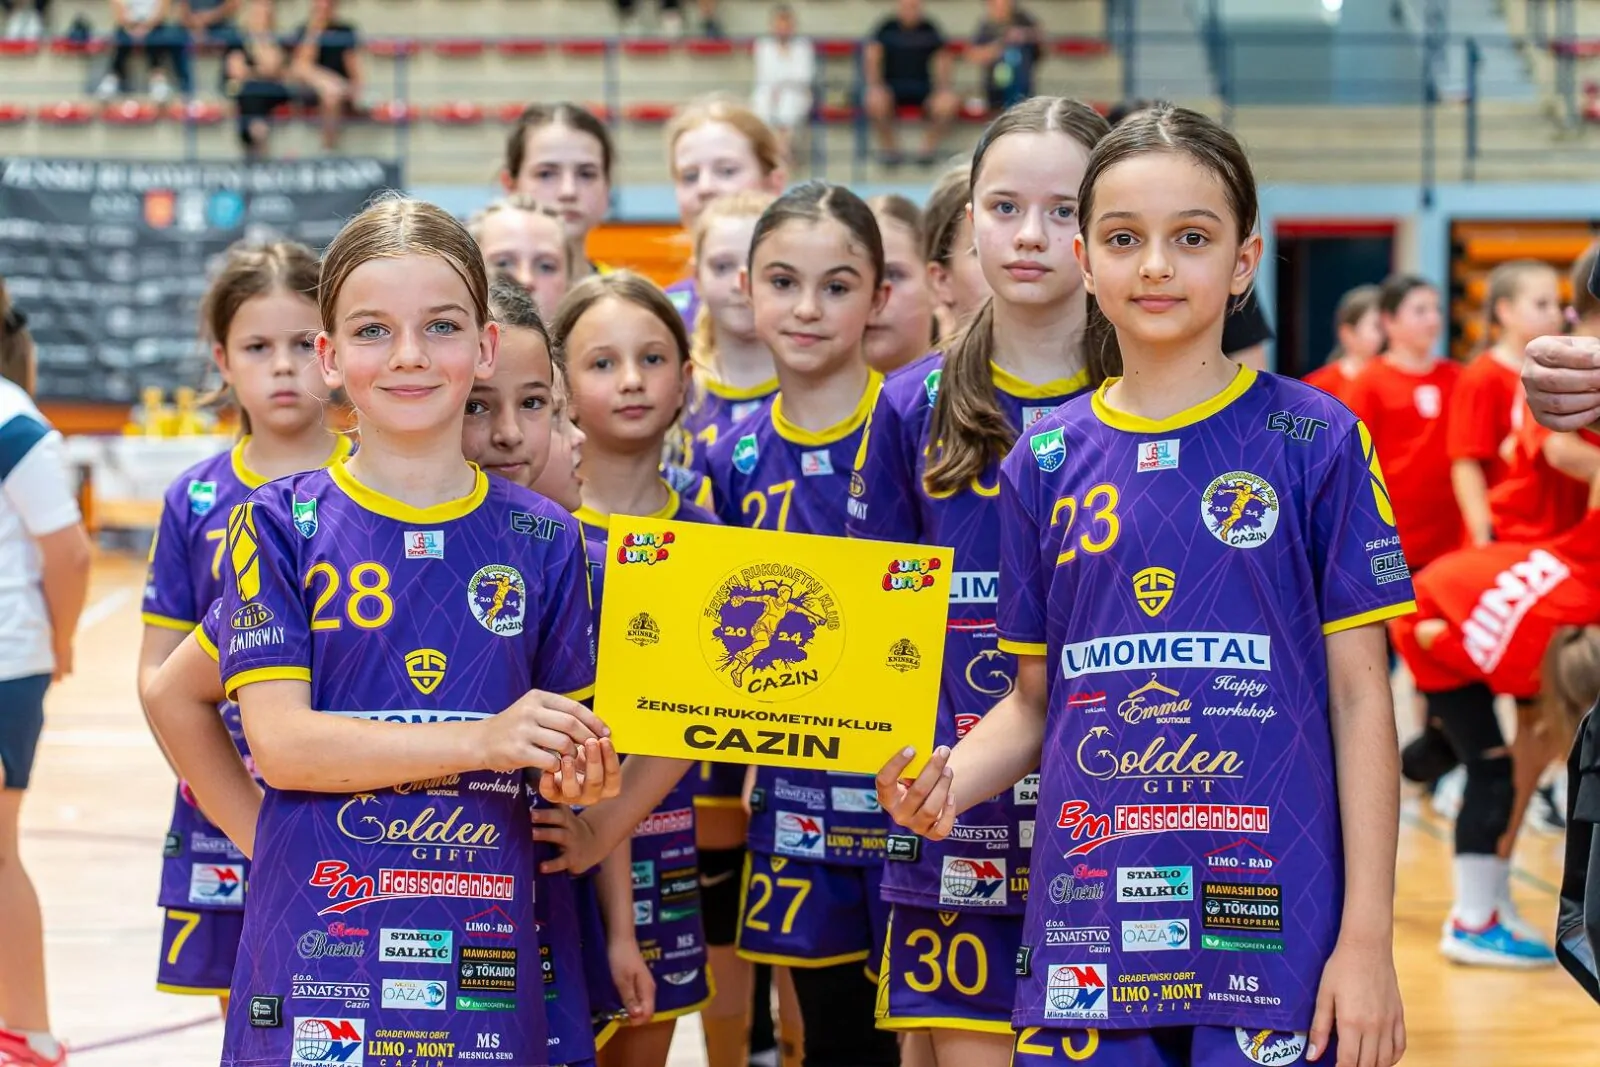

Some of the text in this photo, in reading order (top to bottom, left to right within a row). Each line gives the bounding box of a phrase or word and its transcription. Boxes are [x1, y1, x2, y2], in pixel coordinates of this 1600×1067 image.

[1266, 410, 1329, 442] EXIT
[742, 479, 795, 532] 27
[510, 510, 565, 541] EXIT
[1051, 483, 1120, 567] 23
[1231, 532, 1267, 545] CAZIN
[206, 528, 227, 581] 7
[304, 561, 394, 631] 28
[704, 563, 841, 631] ŽENSKI RUKOMETNI KLUB
[724, 626, 747, 637] 20
[778, 631, 803, 645] 24
[748, 669, 819, 693] CAZIN
[1213, 675, 1268, 697] Happy
[637, 696, 893, 732] ŽENSKI RUKOMETNI KLUB
[1117, 696, 1192, 724] Emma
[1202, 702, 1277, 723] workshop
[684, 724, 840, 760] CAZIN
[1077, 727, 1243, 780] Golden
[1143, 779, 1215, 793] GIFT
[337, 793, 499, 844] Golden
[1057, 800, 1269, 840] BM Fassadenbau
[412, 847, 477, 862] GIFT
[1208, 856, 1239, 867] LIMO
[1248, 857, 1273, 869] RAD
[309, 860, 514, 900] BM Fassadenbau
[1127, 870, 1181, 880] STAKLO
[1122, 882, 1189, 897] SALKIĆ
[1206, 884, 1279, 897] MAWASHI DOO
[745, 873, 812, 934] 27
[466, 922, 490, 932] LIMO
[497, 924, 513, 933] RAD
[1207, 916, 1280, 927] KARATE OPREMA
[167, 909, 200, 965] 7
[390, 932, 442, 941] STAKLO
[1046, 930, 1110, 942] ZANATSTVO
[1124, 929, 1167, 943] OAZA
[385, 946, 448, 958] SALKIĆ
[1089, 945, 1110, 953] Cazin
[1221, 940, 1265, 949] ENVIROGREEN
[463, 949, 516, 959] MAWASHI DOO
[904, 928, 988, 996] 30
[292, 973, 313, 981] d.o.o.
[1173, 972, 1195, 981] OBRT
[1228, 974, 1259, 992] MS
[292, 985, 370, 997] ZANATSTVO
[384, 987, 426, 1000] OAZA
[1112, 985, 1150, 1002] LIMO
[1161, 984, 1203, 1000] MONT
[1208, 992, 1281, 1005] MESNICA SENO
[345, 1001, 370, 1009] Cazin
[1047, 1010, 1107, 1019] Mikra-Matic d.o.o.
[430, 1031, 449, 1040] OBRT
[477, 1033, 500, 1048] MS
[368, 1041, 404, 1056] LIMO
[416, 1042, 454, 1057] MONT
[458, 1051, 514, 1060] MESNICA SENO
[1262, 1043, 1302, 1064] CAZIN
